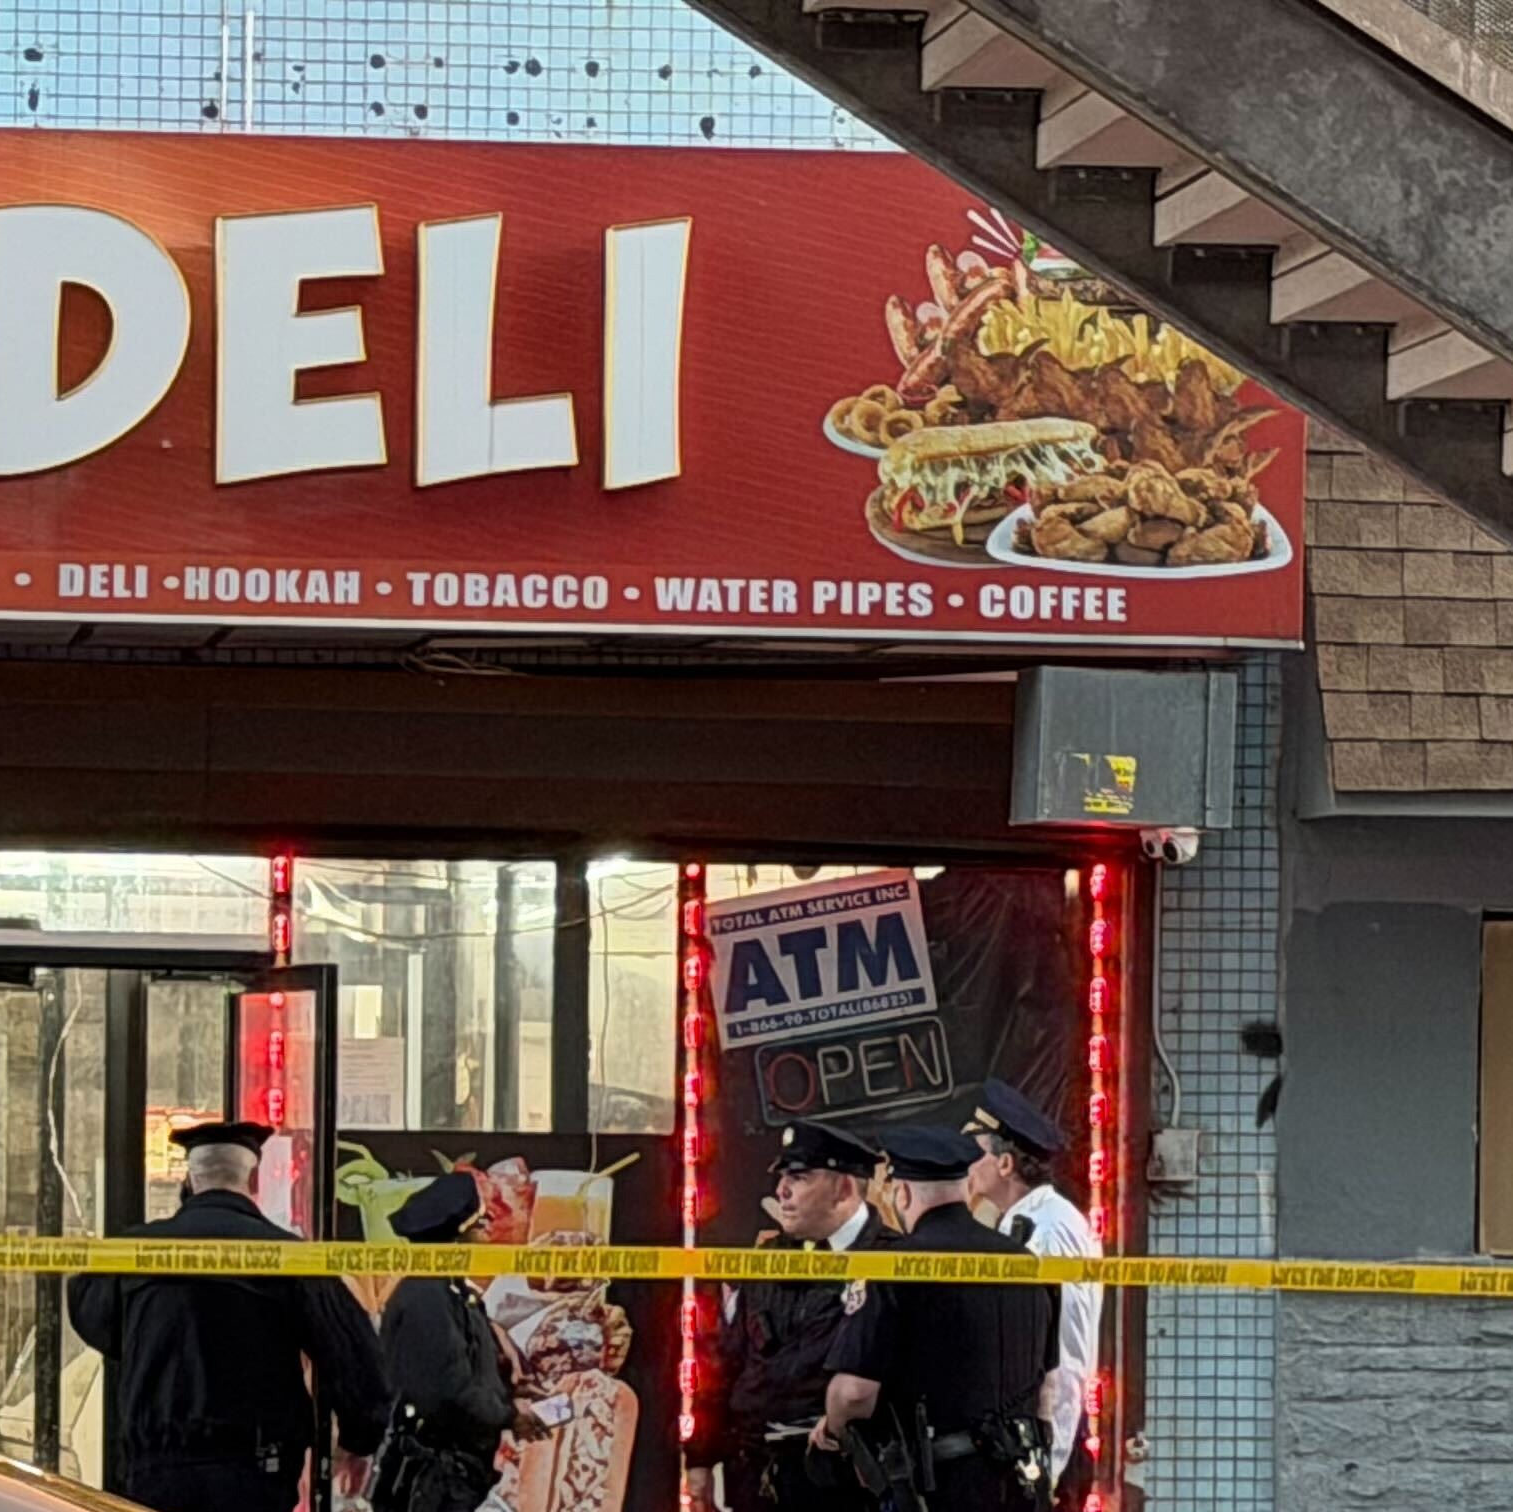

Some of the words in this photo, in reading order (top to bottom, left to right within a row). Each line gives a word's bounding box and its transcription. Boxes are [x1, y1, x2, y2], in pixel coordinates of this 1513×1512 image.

[58, 563, 148, 599] DELI
[183, 567, 361, 604] HOOKAH
[406, 571, 608, 610] TOBACCO
[654, 577, 798, 613] WATER
[812, 579, 934, 617] PIPES
[978, 584, 1128, 622] COFFEE
[711, 911, 765, 934] TOTAL
[769, 903, 804, 923] ATM
[807, 890, 872, 915] SERVICE
[723, 911, 922, 1015] ATM
[768, 1028, 943, 1113] OPEN
